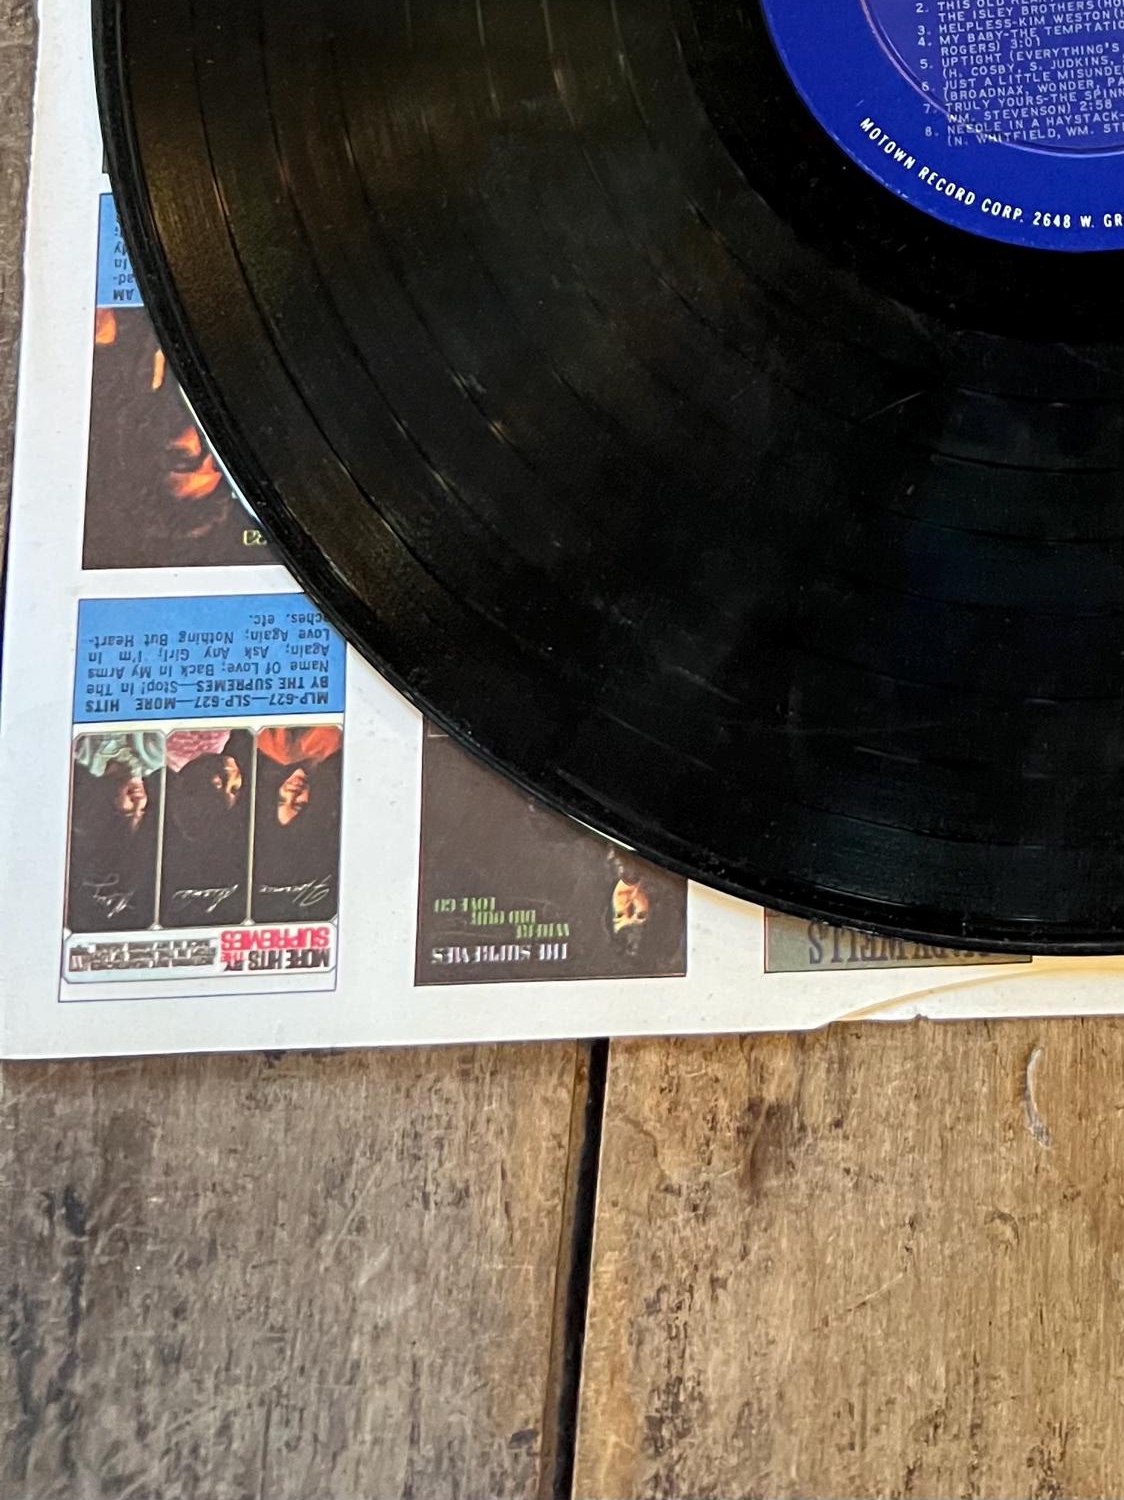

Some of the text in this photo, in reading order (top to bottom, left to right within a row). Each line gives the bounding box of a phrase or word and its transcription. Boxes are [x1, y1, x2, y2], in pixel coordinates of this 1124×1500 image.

[915, 2, 929, 14] 2.
[938, 0, 971, 11] THIS
[938, 11, 966, 22] THE
[972, 7, 1013, 20] ISLEY
[917, 35, 932, 47] 4.
[940, 33, 960, 44] MY
[941, 37, 1041, 56] ROGERS) 3:01
[920, 58, 933, 69] 5.
[942, 52, 1002, 67] UPTIGHT
[1010, 42, 1120, 62] (EVERYTHING'S
[943, 77, 977, 90] JUST
[1000, 70, 1051, 85] LITTLE
[944, 84, 1029, 102] (BROADNAX,
[1037, 78, 1100, 95] WONDER,
[860, 117, 916, 170] MOTOWN
[918, 166, 976, 206] RECORD
[981, 198, 1024, 223] CORP.
[1032, 211, 1071, 228] 2648
[1080, 215, 1095, 228] W.
[88, 635, 134, 648] Heart-
[144, 633, 169, 646] But
[178, 630, 234, 644] Nothing
[299, 628, 330, 641] Love
[88, 652, 103, 664] In
[119, 650, 142, 663] I'm
[204, 646, 230, 660] Any
[244, 646, 269, 659] Ask
[131, 664, 152, 679] My
[159, 666, 173, 678] In
[180, 663, 214, 677] Back
[265, 661, 281, 674] Of
[290, 660, 329, 672] Name
[88, 667, 125, 680] Arms
[86, 675, 329, 696] BY THE In The
[85, 700, 119, 713] HITS
[220, 926, 331, 950] SUPREMES
[248, 949, 330, 969] MORE HITS
